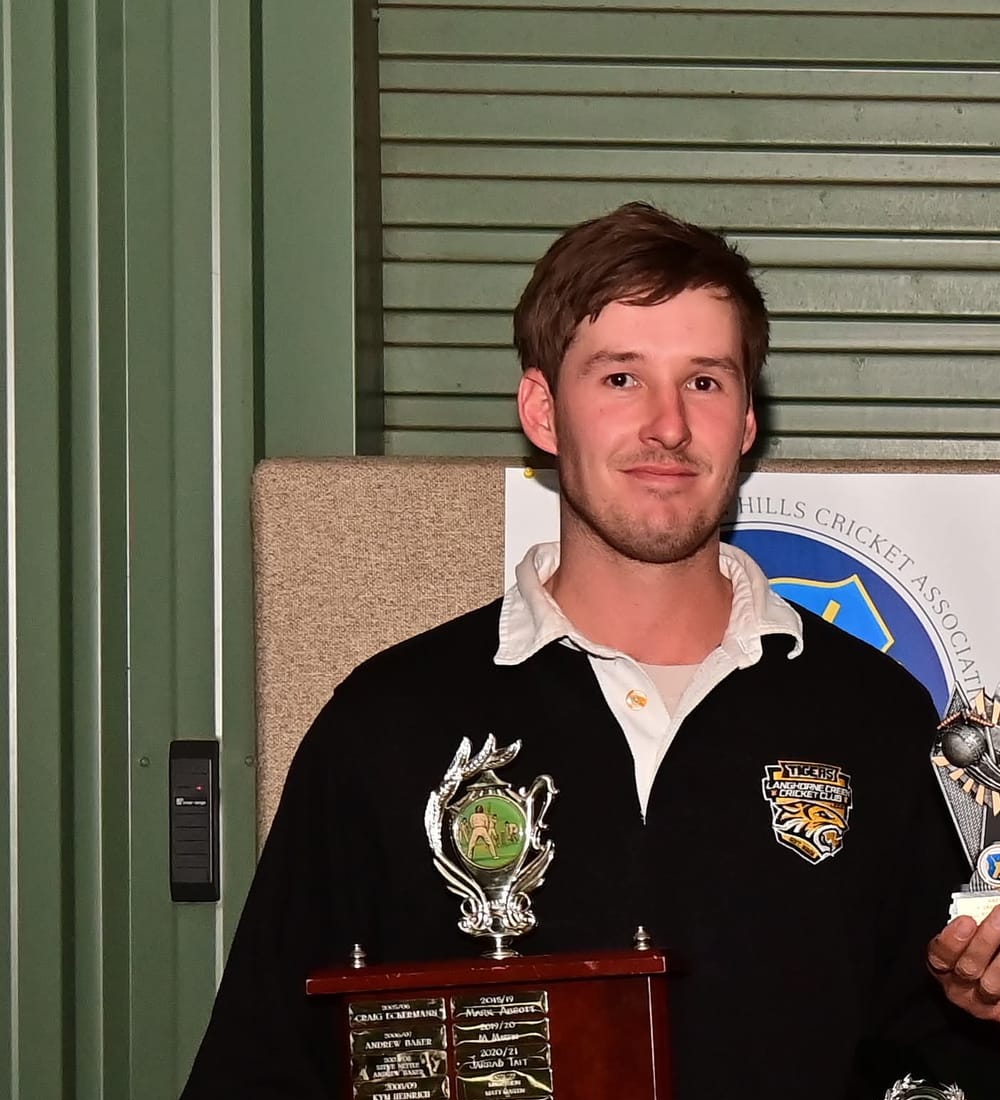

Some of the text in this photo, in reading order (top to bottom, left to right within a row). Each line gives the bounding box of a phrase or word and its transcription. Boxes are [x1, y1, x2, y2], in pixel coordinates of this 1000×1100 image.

[738, 496, 806, 519] HILLS
[815, 507, 915, 571] CRICKET
[787, 765, 835, 780] TIGERS
[766, 780, 850, 796] LANGHORNE CREEK
[779, 789, 842, 802] CRICKET CLUB
[354, 1012, 383, 1022] CRAIG
[365, 1038, 432, 1050] ANDREW BAKER
[480, 1046, 518, 1058] 2020/21
[393, 1090, 431, 1100] HEINRICH
